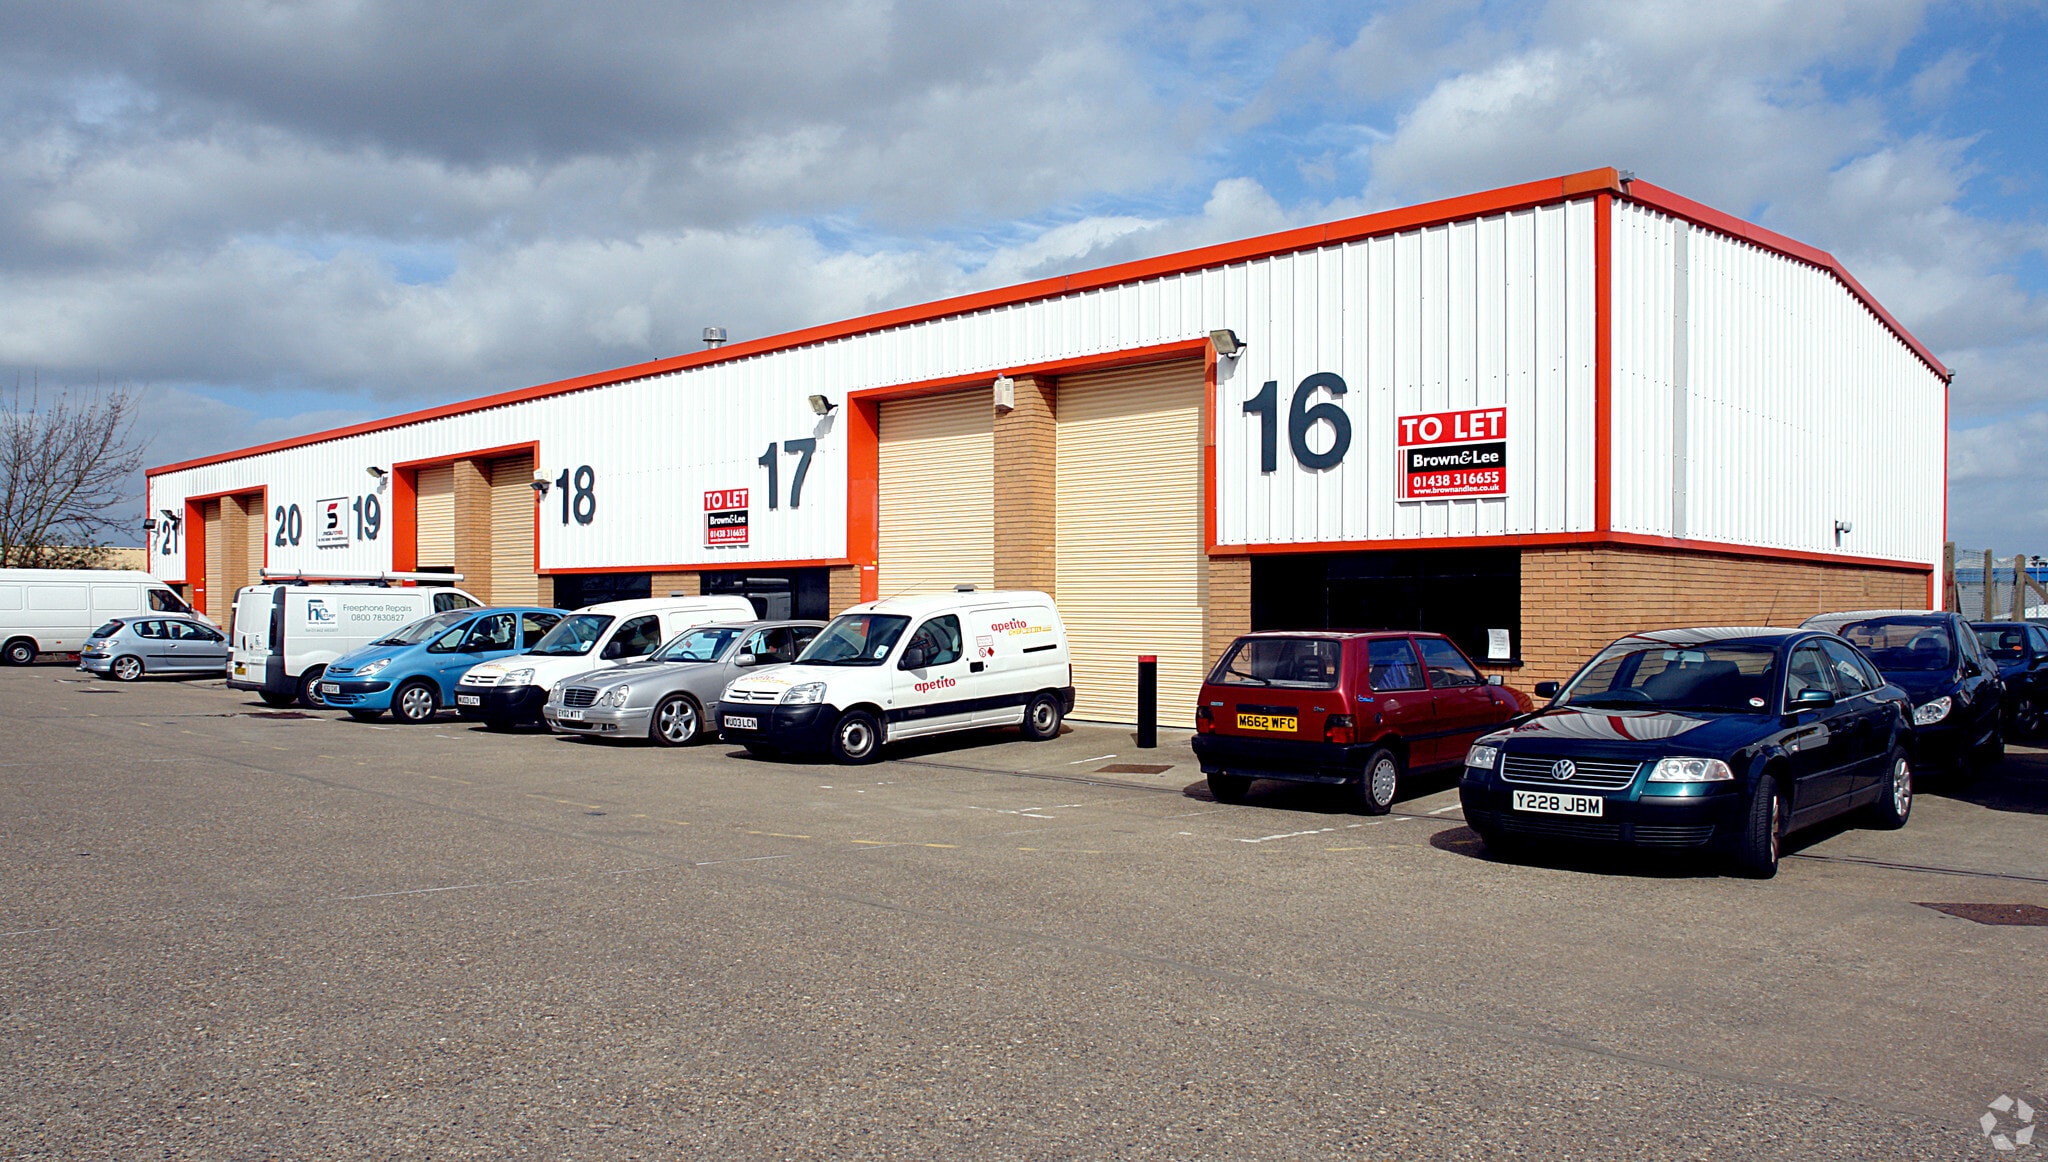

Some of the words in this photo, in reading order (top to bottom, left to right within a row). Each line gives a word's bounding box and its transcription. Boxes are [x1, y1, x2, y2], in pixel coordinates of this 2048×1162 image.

[1243, 372, 1352, 472] 16
[1402, 417, 1443, 442] TO
[1455, 411, 1503, 439] LET
[1413, 450, 1499, 467] Brown&Lee
[758, 437, 816, 510] 17
[1413, 475, 1450, 488] 01438
[1453, 471, 1499, 486] 316655
[556, 465, 596, 526] 18
[1413, 484, 1499, 495] www.brownandlee.co.uk
[705, 492, 723, 509] TO
[726, 490, 748, 508] LET
[275, 504, 302, 547] 20
[353, 494, 381, 541] 19
[162, 520, 178, 556] 21
[343, 604, 384, 613] Freephone
[386, 604, 412, 613] Repairs
[351, 613, 371, 621] 0800
[991, 618, 1027, 633] apetito
[914, 676, 956, 693] apetito
[1239, 715, 1268, 728] M662
[1271, 718, 1295, 729] WFC
[1517, 793, 1560, 811] Y228
[1564, 797, 1600, 814] JBM
